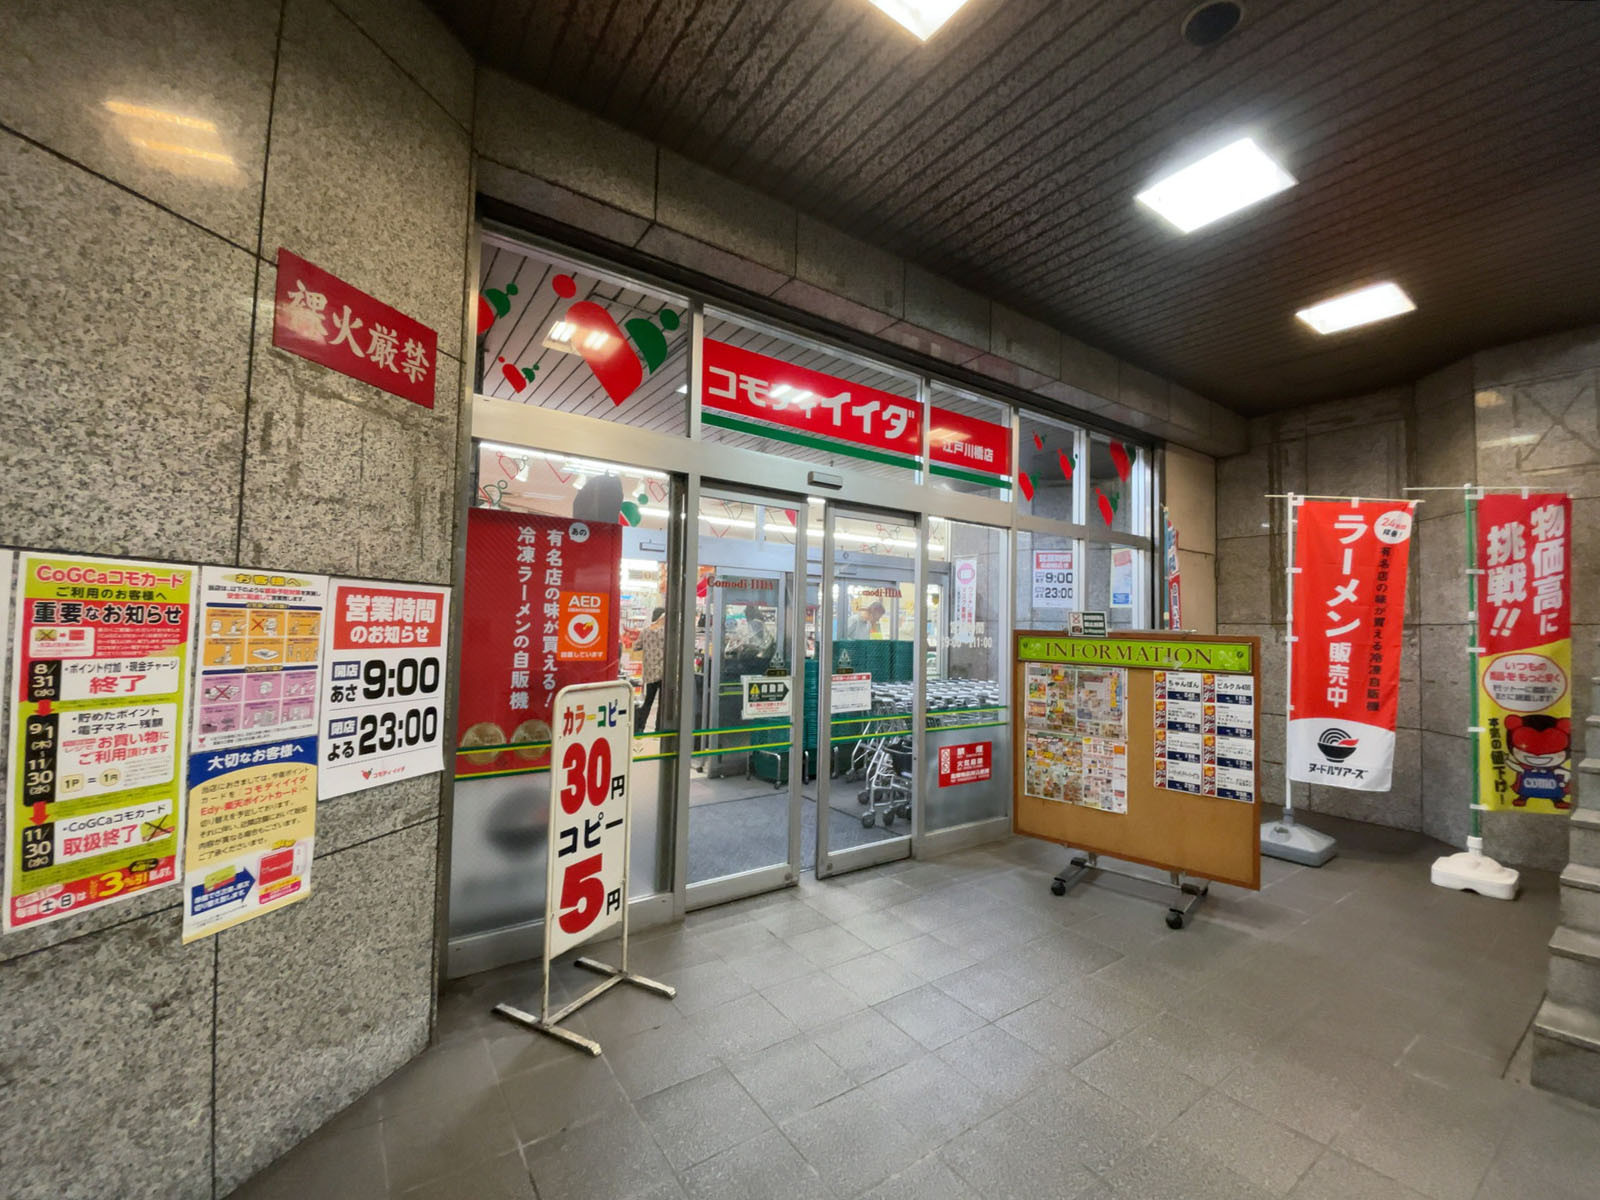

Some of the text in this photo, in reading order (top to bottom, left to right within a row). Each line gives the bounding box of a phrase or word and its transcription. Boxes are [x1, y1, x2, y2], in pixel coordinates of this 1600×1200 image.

[708, 366, 915, 439] コモディイイダ
[570, 528, 588, 537] あの
[36, 565, 185, 588] CoGCaコモカード
[1045, 572, 1073, 584] 9:00
[1530, 504, 1566, 636] 物価高に
[56, 587, 167, 601] ご利用のお客様へ
[568, 594, 601, 608] AED
[32, 601, 182, 625] 重要なお知らせ
[345, 594, 437, 624] 営業時間
[510, 526, 537, 710] 冷凍ラーメンの自販機
[1325, 514, 1368, 709] ラーメン販売中
[350, 625, 430, 644] のお知らせ
[1046, 642, 1213, 666] INFORMATION
[334, 663, 358, 679] 開店
[1504, 662, 1548, 672] いつもの
[32, 675, 54, 688] 31
[89, 674, 147, 695] 終了
[362, 657, 440, 700] 9:00
[330, 684, 358, 703] あさ
[331, 719, 356, 737] 閉店
[563, 699, 627, 737] カラーコピー
[97, 731, 170, 749] お買い物に
[358, 706, 438, 757] 23:00
[207, 744, 304, 771] 大切なお客様へ
[327, 741, 355, 762] よる
[26, 770, 54, 787] 30
[1308, 763, 1369, 780] ヌードルツアーズ
[62, 823, 139, 857] 取扱終了
[558, 811, 624, 859] コピー
[24, 841, 52, 859] 30
